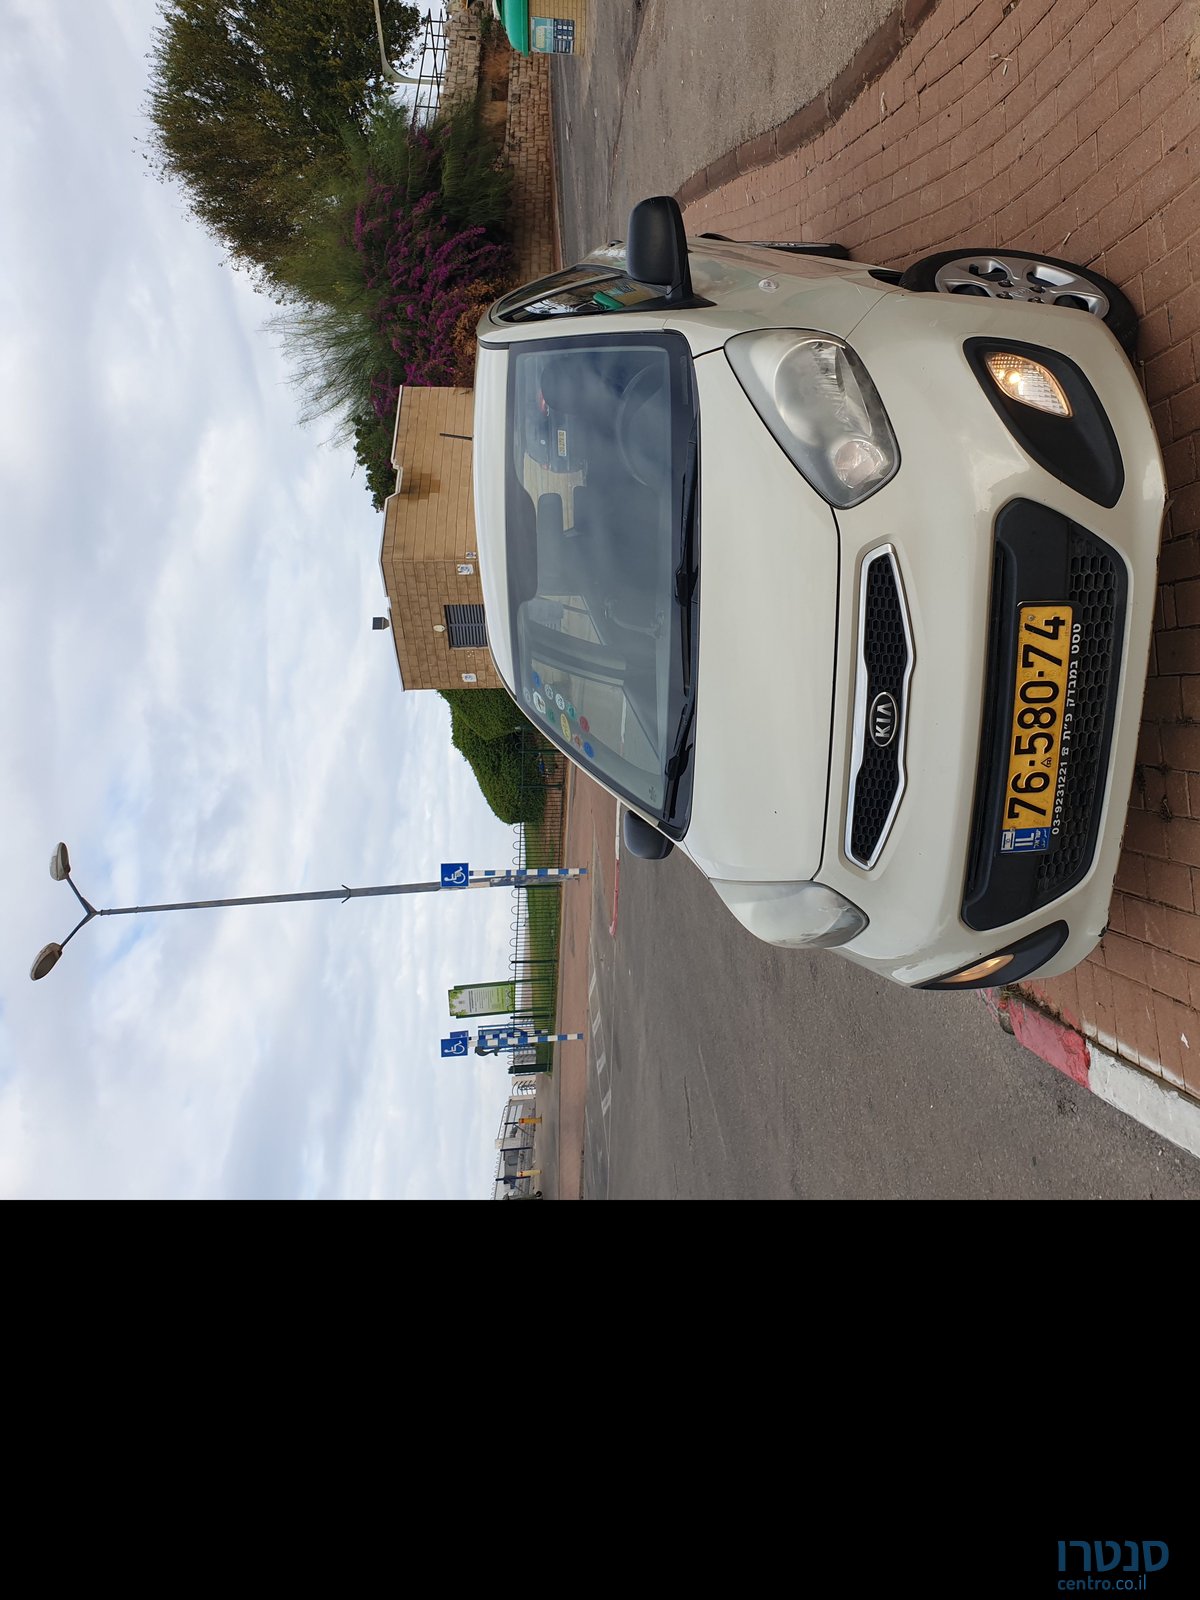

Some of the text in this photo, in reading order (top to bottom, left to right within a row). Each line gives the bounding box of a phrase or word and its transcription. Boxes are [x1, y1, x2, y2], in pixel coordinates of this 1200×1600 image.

[1071, 623, 1081, 654] טסט
[1066, 660, 1078, 707] במבדק
[875, 702, 893, 738] KIA
[1051, 761, 1068, 835] 03-9231221
[1014, 832, 1035, 847] IL
